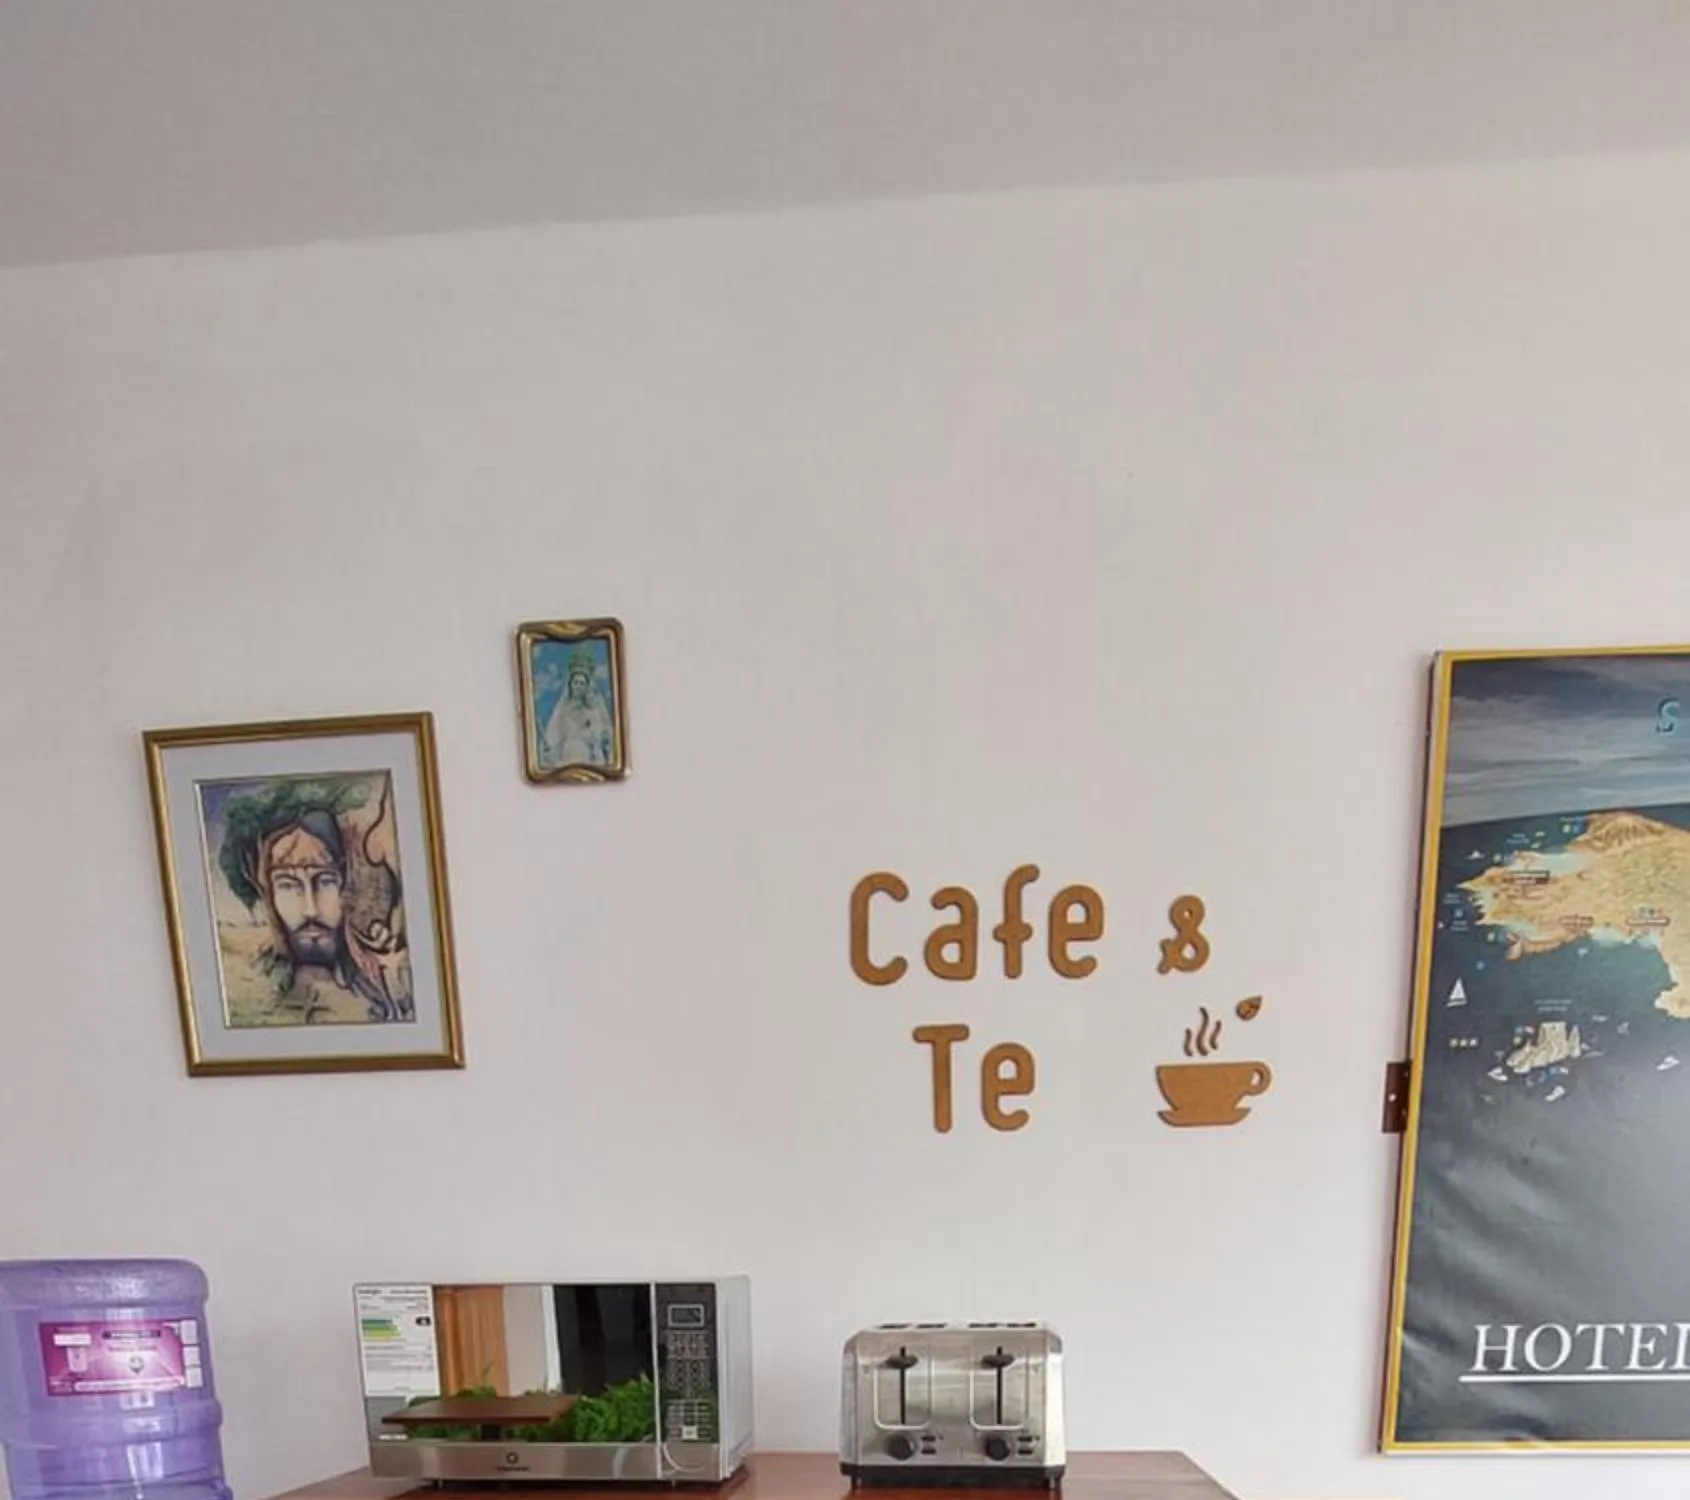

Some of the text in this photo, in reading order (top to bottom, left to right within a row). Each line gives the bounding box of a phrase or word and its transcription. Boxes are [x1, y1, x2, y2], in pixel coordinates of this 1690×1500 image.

[849, 863, 1210, 986] Cafe &
[911, 1023, 1036, 1134] Te
